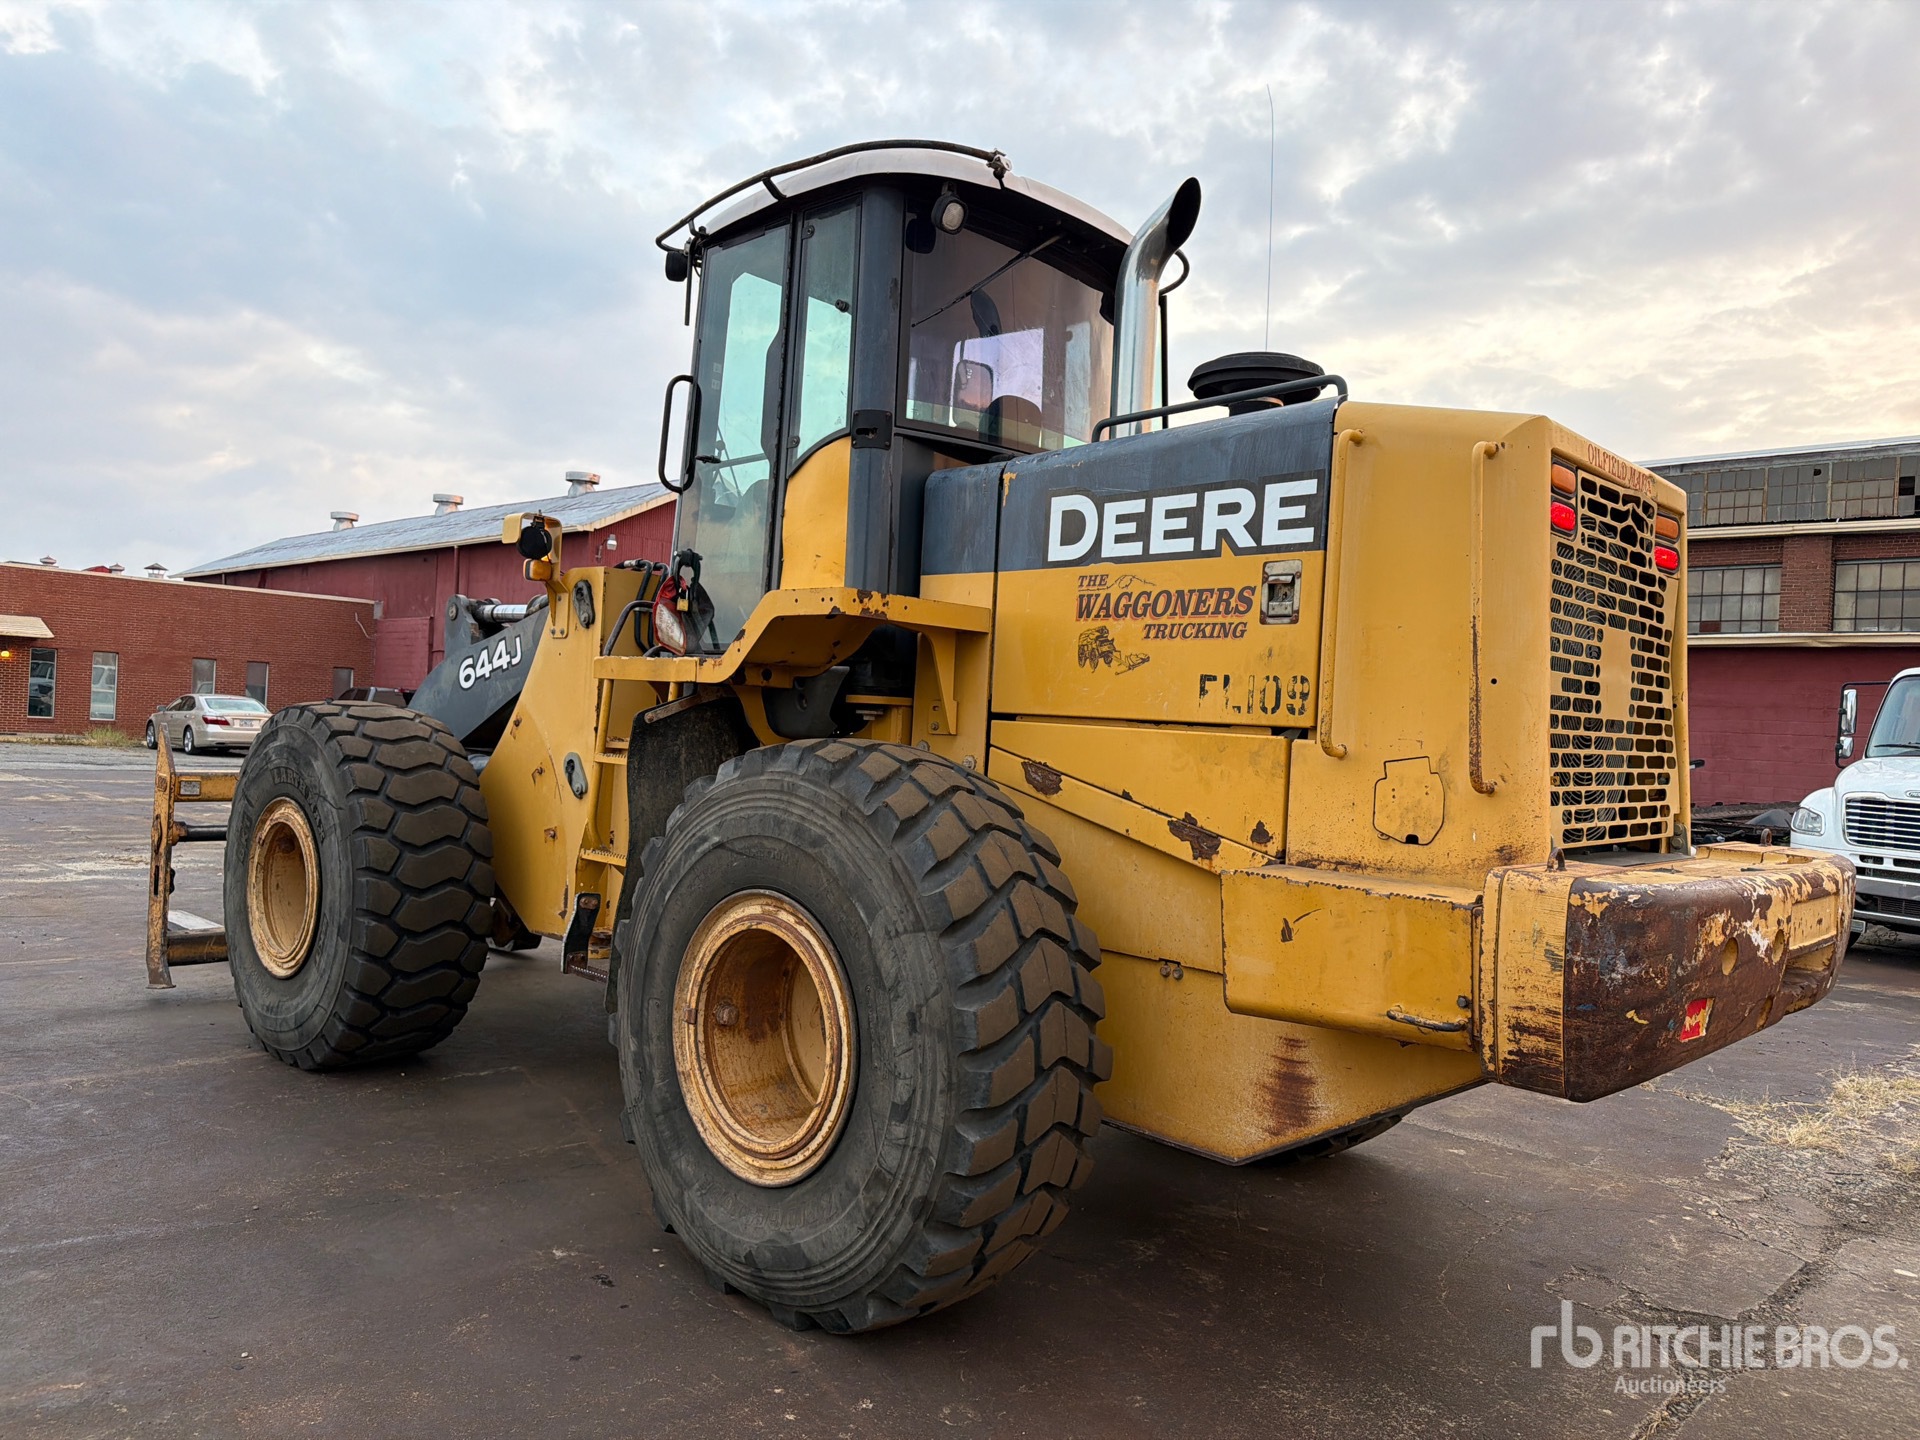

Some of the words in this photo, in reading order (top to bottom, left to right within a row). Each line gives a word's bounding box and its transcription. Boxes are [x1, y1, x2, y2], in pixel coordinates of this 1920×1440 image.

[1587, 443, 1628, 481] OILFIELD
[1048, 479, 1318, 563] DEERE
[1077, 574, 1110, 588] THE
[1076, 585, 1257, 621] WAGGONERS
[1142, 622, 1248, 640] TRUCKING
[459, 637, 522, 690] 644J
